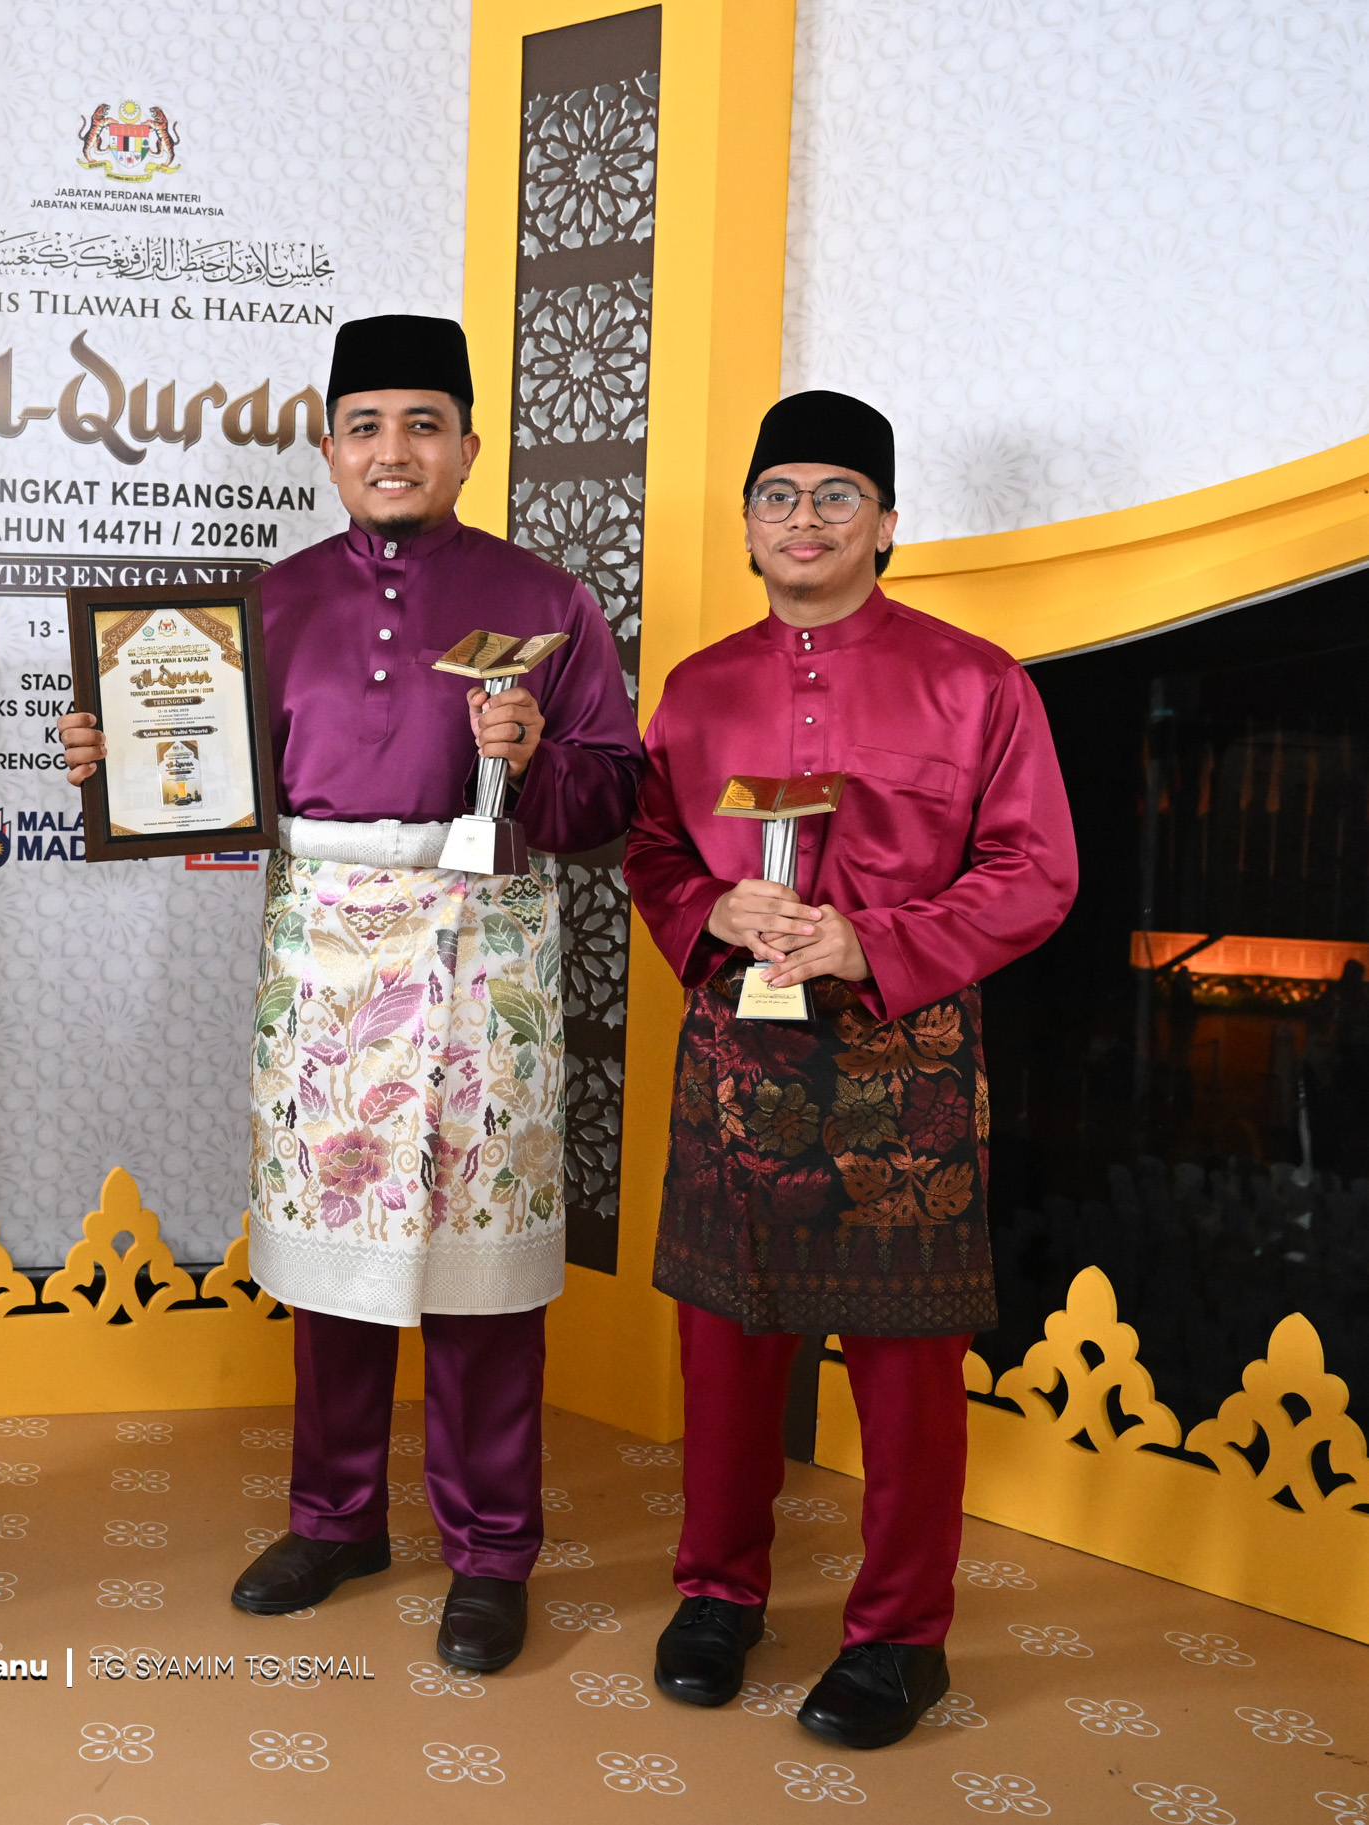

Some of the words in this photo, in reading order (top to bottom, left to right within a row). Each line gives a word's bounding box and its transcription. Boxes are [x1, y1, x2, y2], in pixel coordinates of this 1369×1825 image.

[54, 188, 102, 199] JABATAN
[104, 190, 154, 201] PERDANA
[156, 192, 201, 203] MENTERI
[30, 199, 78, 210] JABATAN
[80, 201, 137, 213] KEMAJUAN
[139, 204, 171, 214] ISLAM
[173, 205, 225, 217] MALAYSIA
[171, 296, 195, 320] &
[111, 481, 316, 512] KEBANGSAAN
[78, 519, 162, 546] 1447H
[172, 521, 182, 546] /
[190, 521, 278, 548] 2026M
[28, 620, 51, 638] 13
[20, 673, 73, 691] STAD
[24, 699, 76, 718] SUKA
[152, 698, 194, 706] TERENGGANU
[17, 810, 83, 832] MALA
[17, 835, 87, 862] MAD
